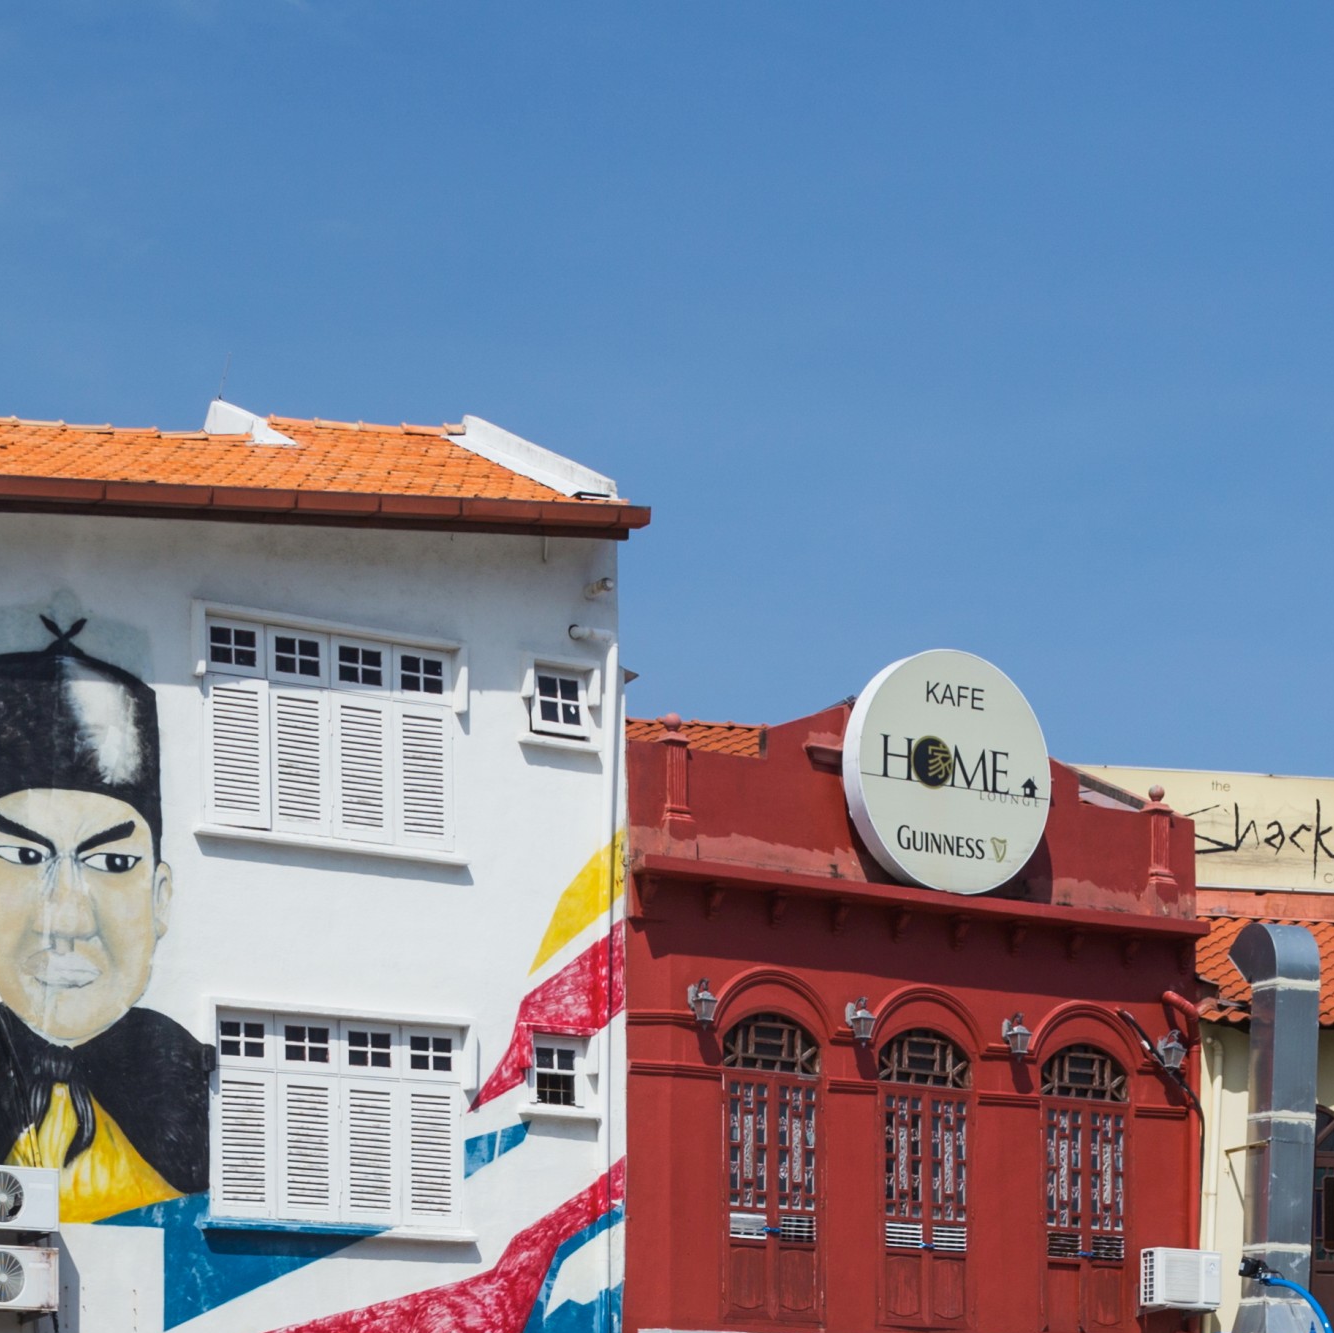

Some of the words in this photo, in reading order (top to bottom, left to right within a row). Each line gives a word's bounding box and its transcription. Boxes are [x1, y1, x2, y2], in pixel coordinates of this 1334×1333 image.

[926, 681, 985, 711] KAFE
[1211, 780, 1231, 792] the
[979, 790, 1040, 808] LOUNGE
[897, 824, 986, 861] GUINNESS
